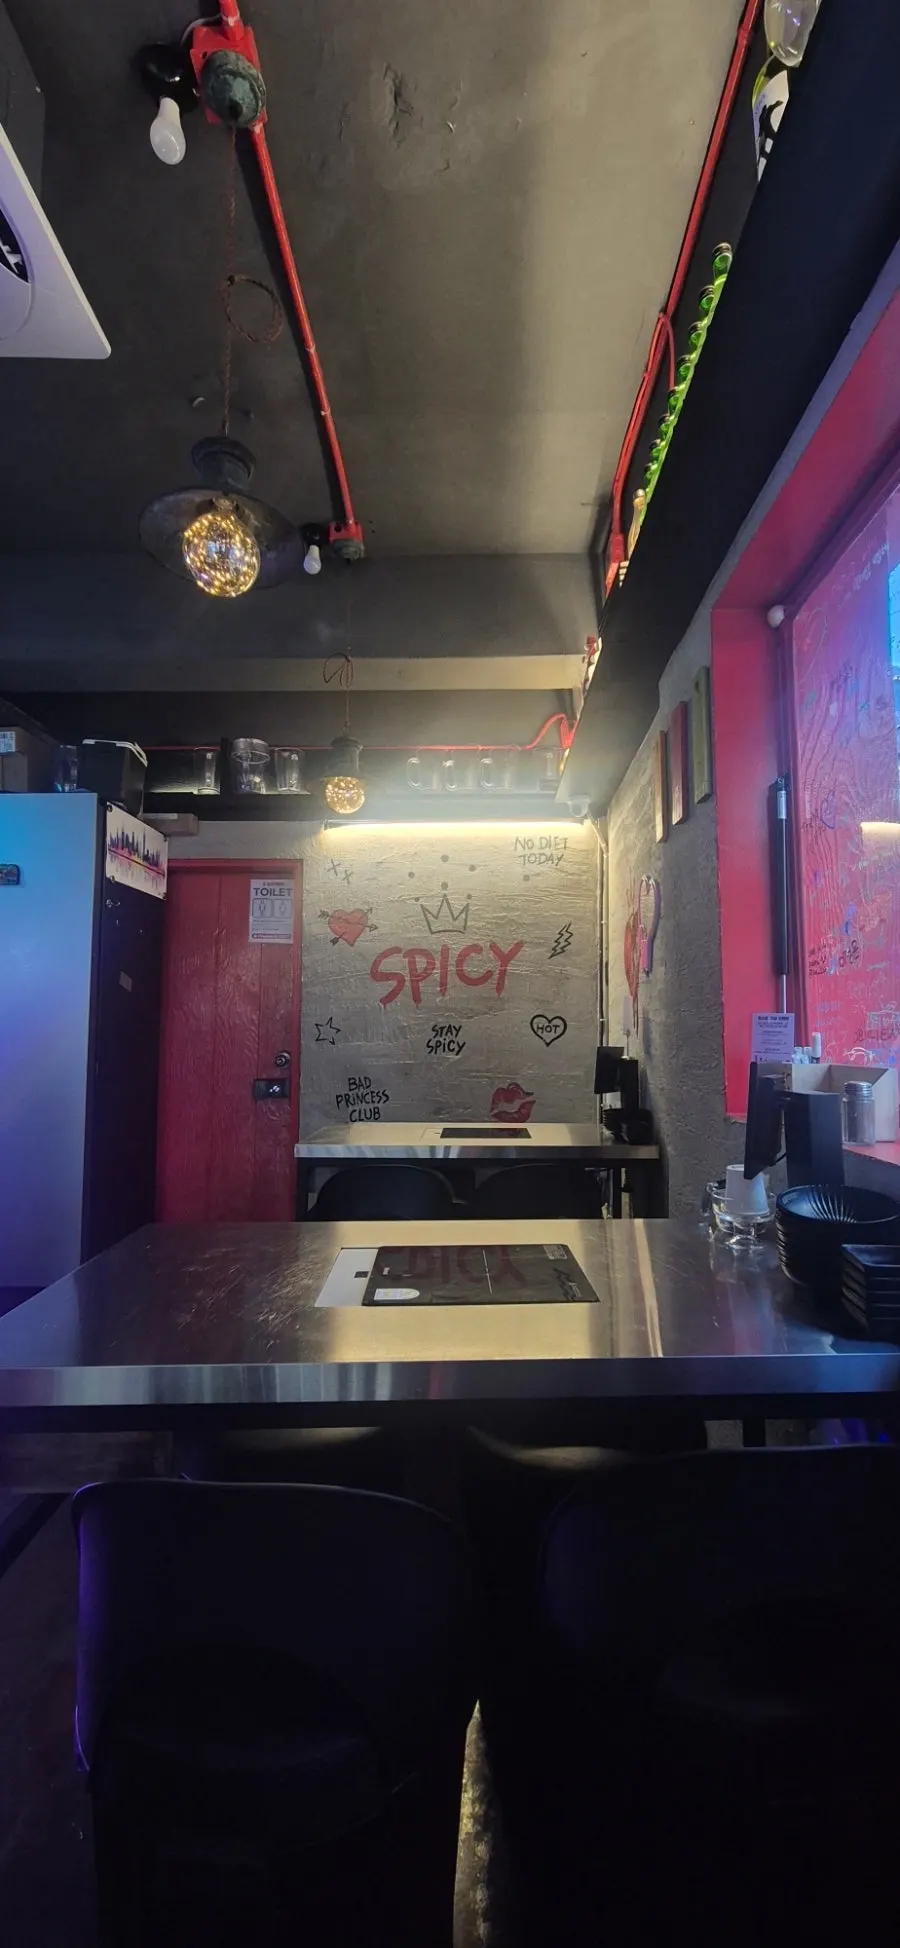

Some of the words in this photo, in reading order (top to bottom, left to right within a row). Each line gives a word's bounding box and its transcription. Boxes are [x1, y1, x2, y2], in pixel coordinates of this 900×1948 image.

[514, 836, 534, 850] NO
[539, 835, 569, 850] DIET
[519, 853, 565, 866] TODAY
[253, 887, 293, 896] TOILET
[369, 939, 525, 1009] SPICY
[431, 1023, 463, 1038] STAY
[536, 1023, 562, 1034] HOT
[348, 1077, 372, 1092] BAD
[349, 1106, 382, 1123] CLUB
